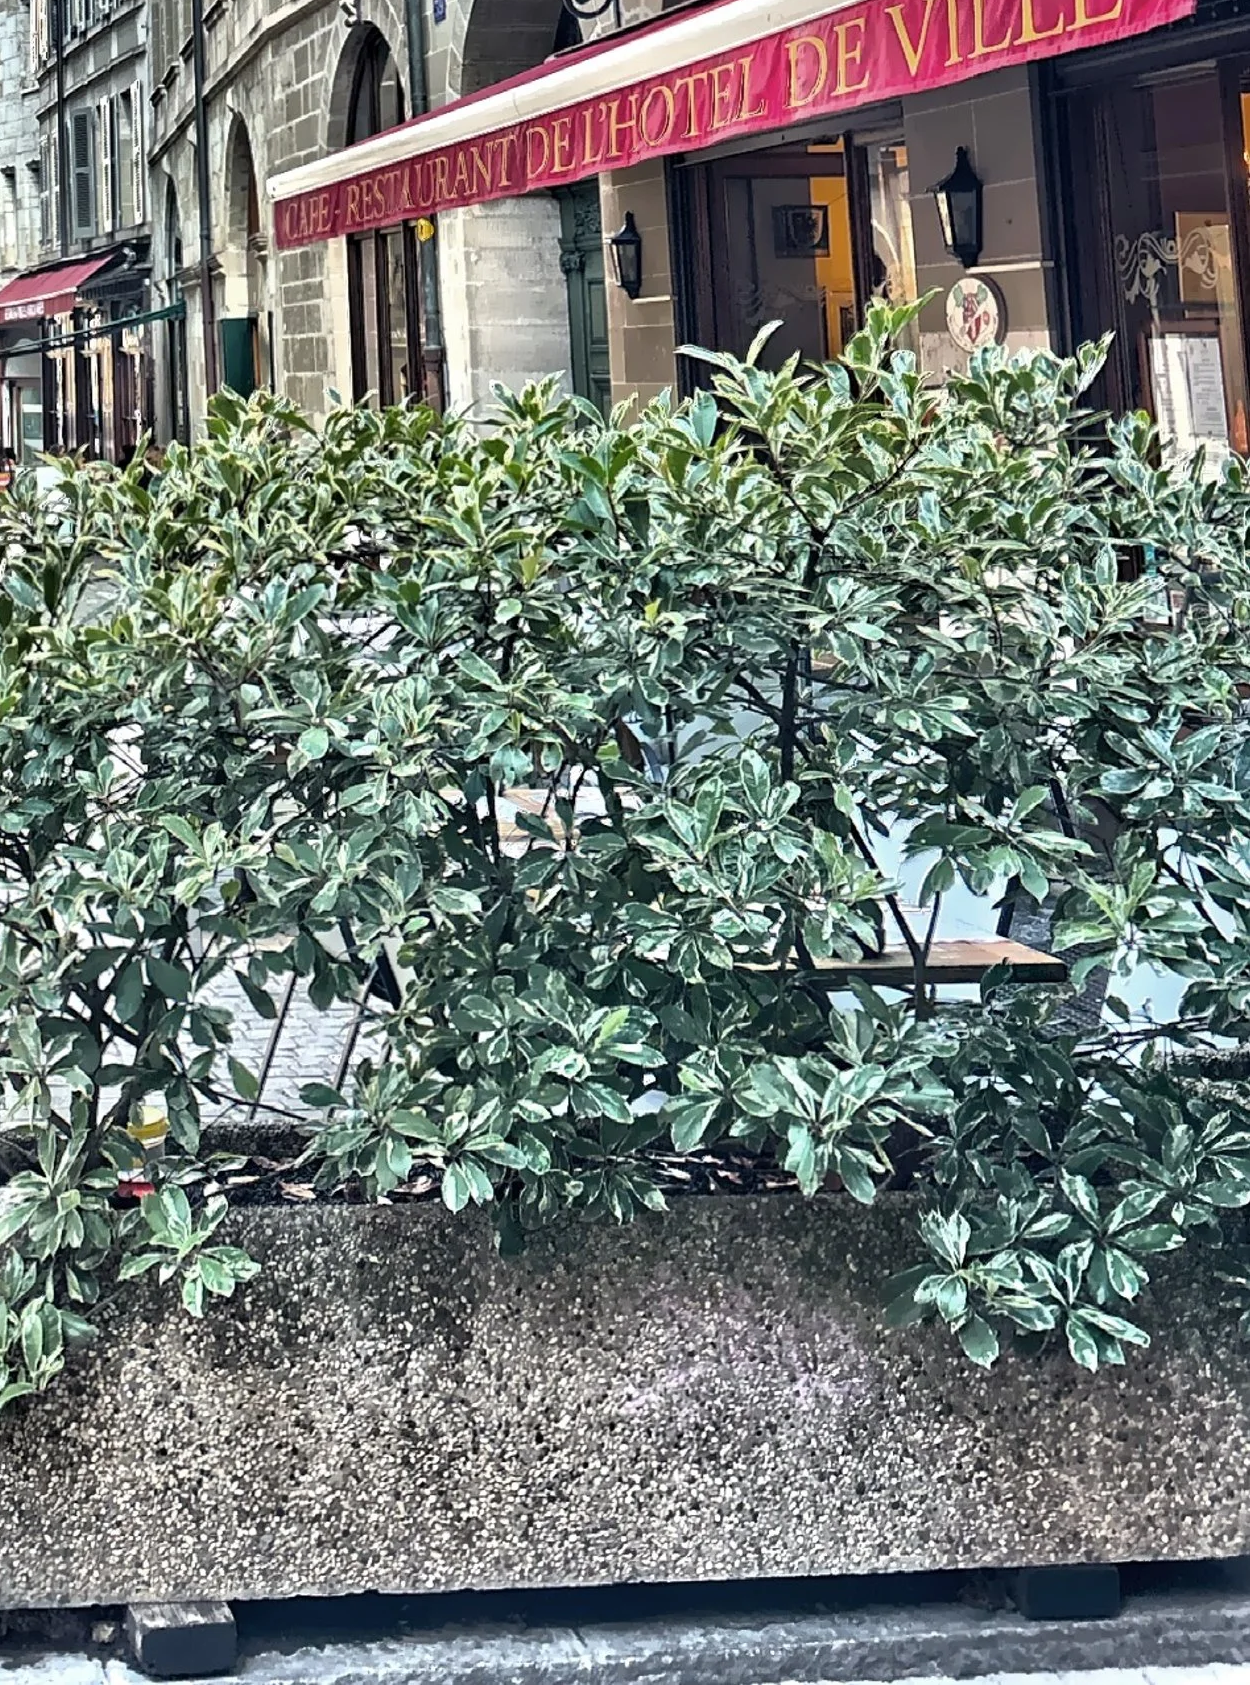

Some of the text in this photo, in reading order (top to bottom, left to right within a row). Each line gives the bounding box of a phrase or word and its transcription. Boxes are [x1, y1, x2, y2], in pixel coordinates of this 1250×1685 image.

[345, 132, 516, 226] RESTAURANT
[526, 116, 576, 180] DE
[784, 17, 870, 110] DE
